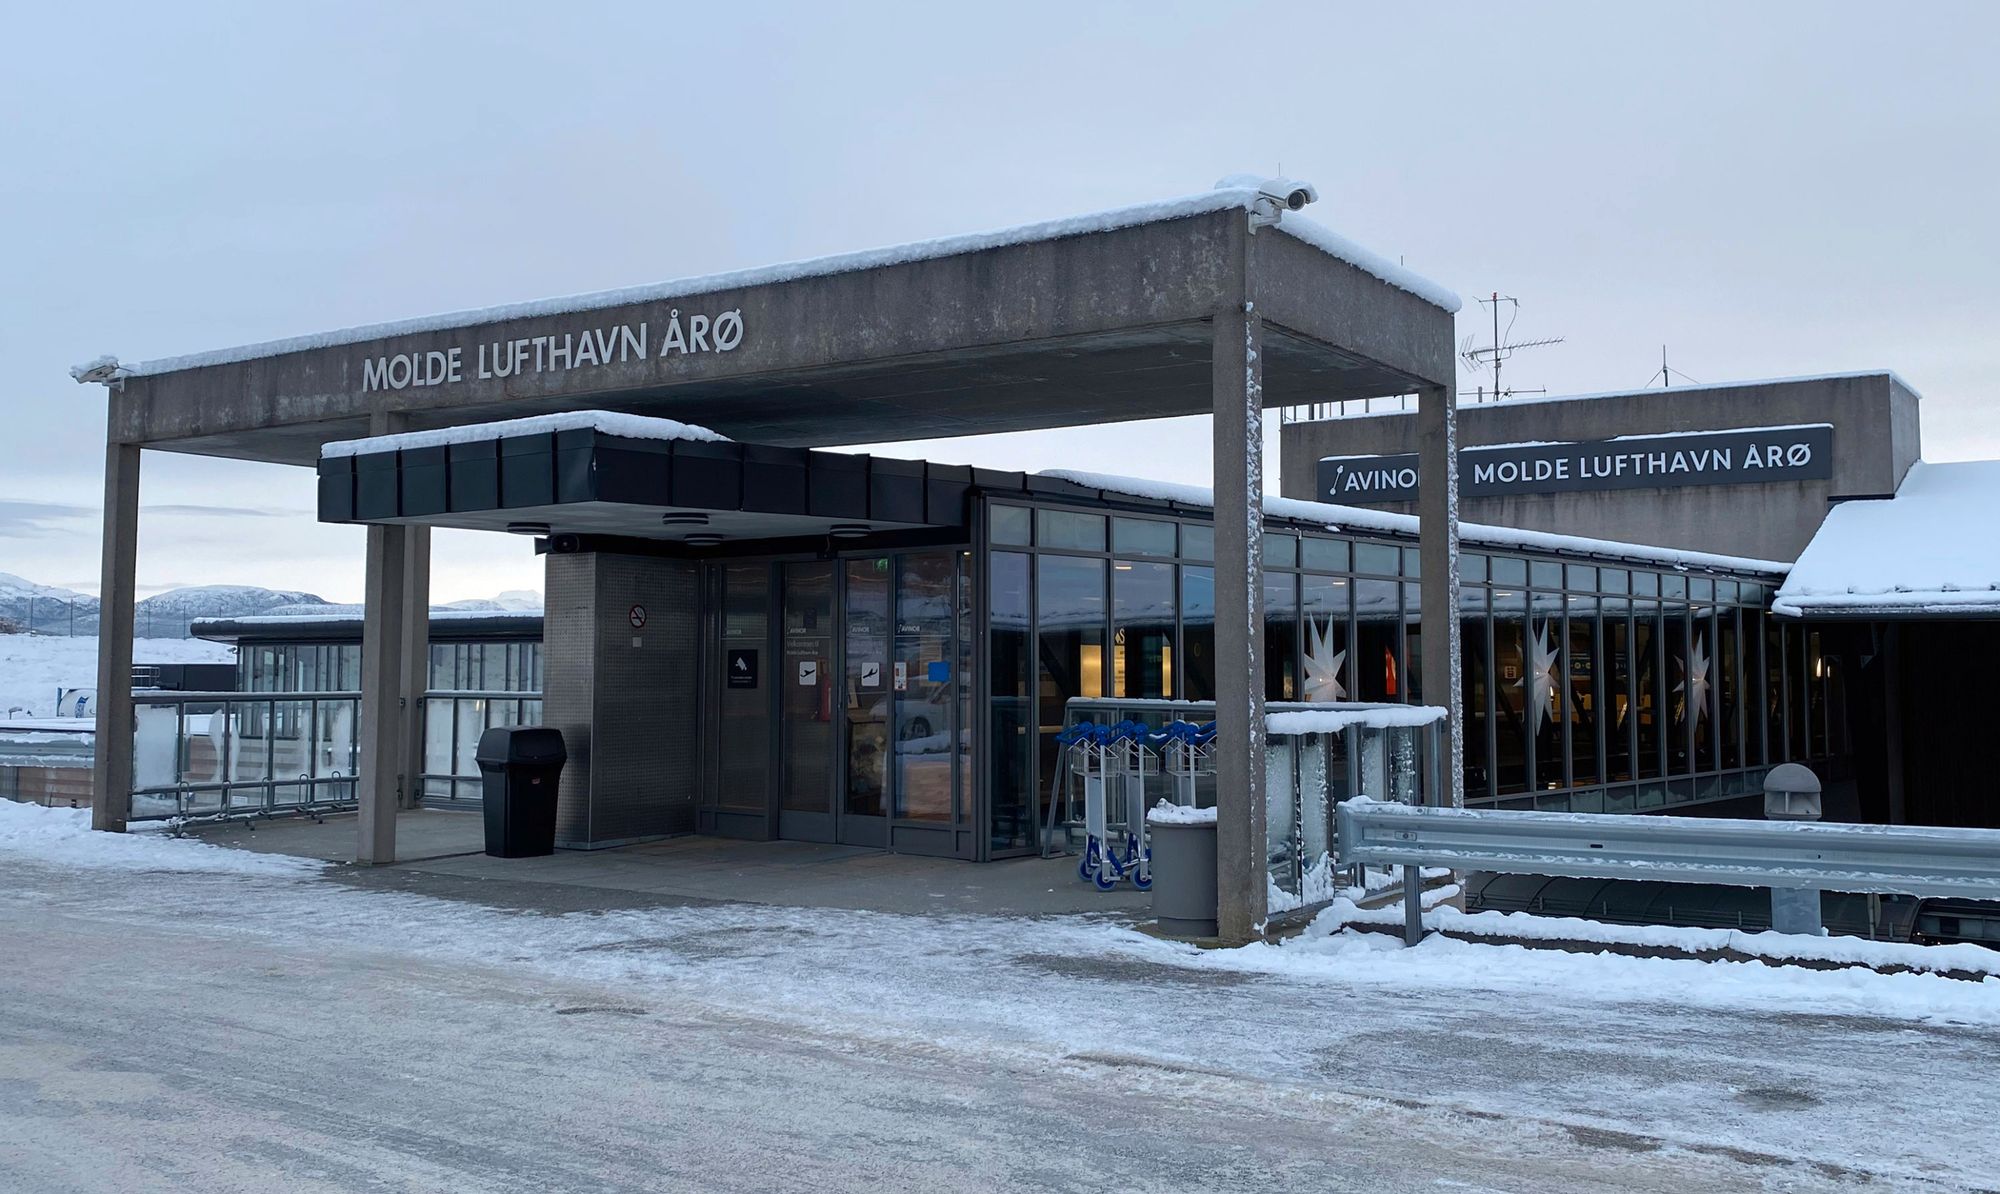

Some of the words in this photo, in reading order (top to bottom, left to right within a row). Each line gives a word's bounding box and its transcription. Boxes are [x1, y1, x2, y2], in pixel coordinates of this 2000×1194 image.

[362, 347, 462, 392] MOLDE
[478, 322, 647, 379] LUFTHAVN
[660, 308, 744, 355] ÅRØ
[1344, 468, 1420, 492] AVINO
[1474, 458, 1570, 484] MOLDE
[1580, 448, 1731, 478] LUFTHAVN
[1743, 443, 1811, 469] ÅRØ
